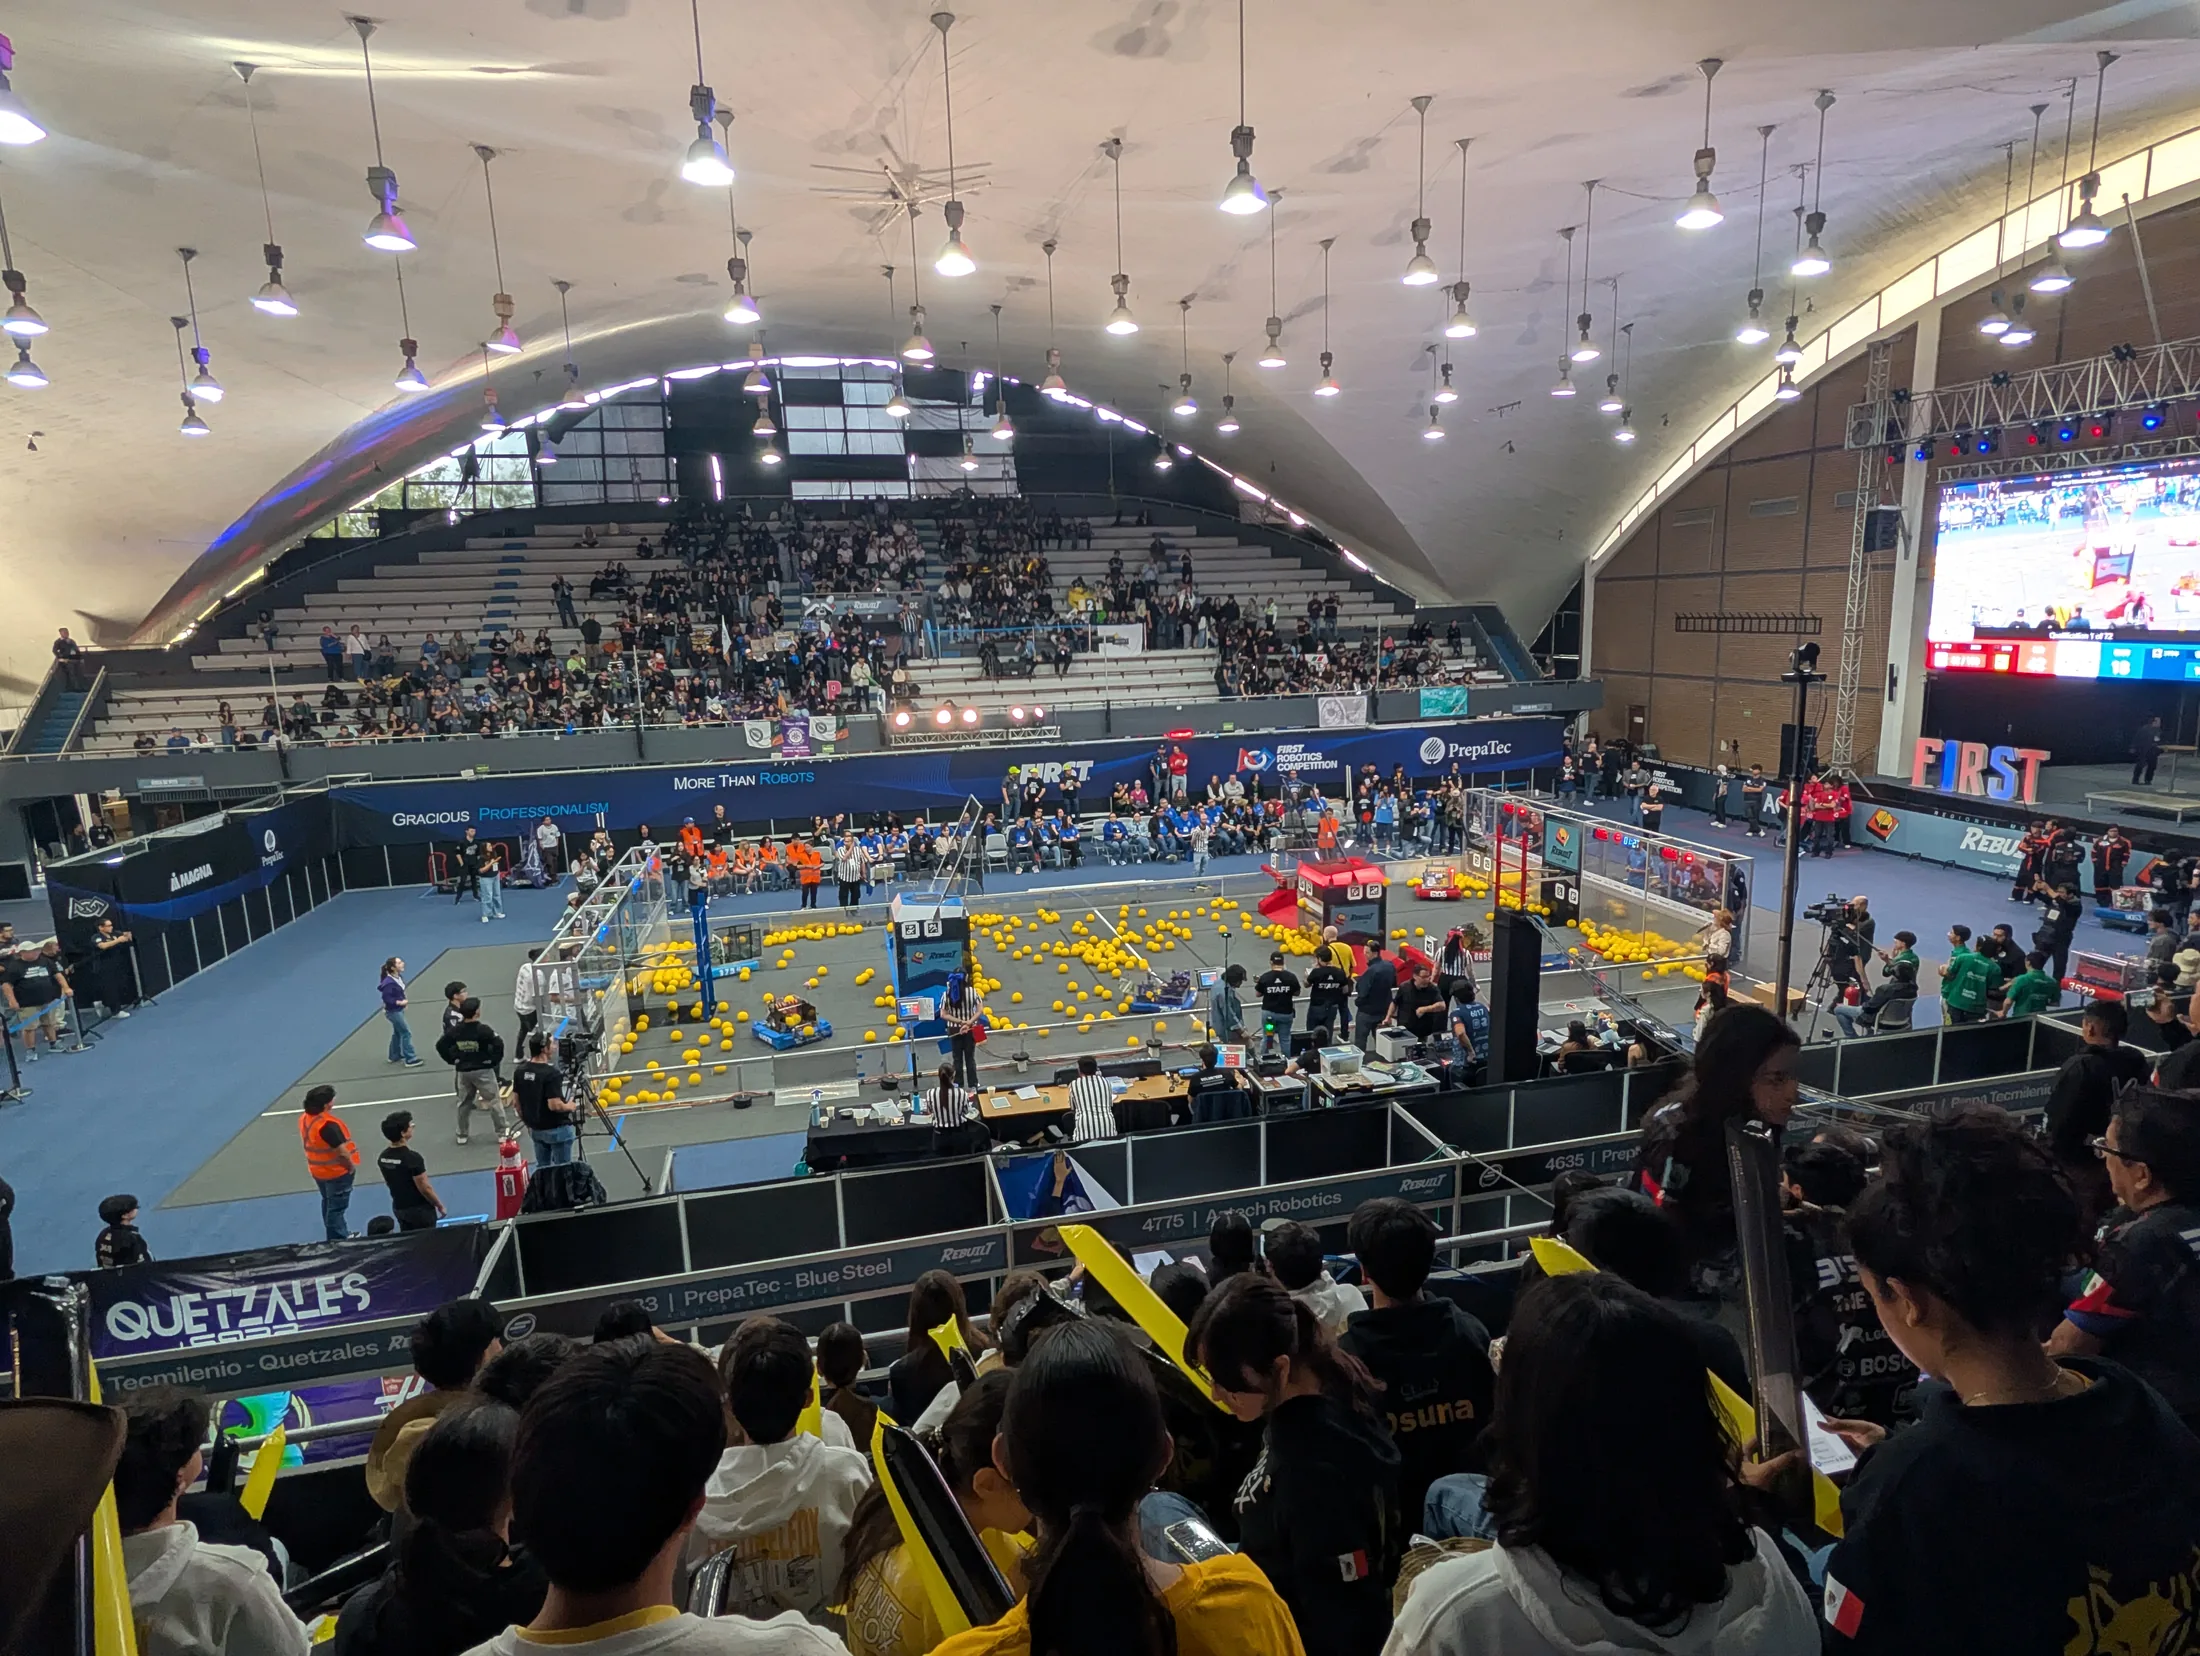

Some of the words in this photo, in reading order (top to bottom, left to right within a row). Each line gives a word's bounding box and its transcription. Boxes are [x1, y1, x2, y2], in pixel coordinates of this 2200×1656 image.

[1276, 743, 1305, 754] FIRST
[1276, 751, 1322, 763] ROBOTICS
[1448, 740, 1511, 760] PrepaTec
[1277, 759, 1338, 772] COMPETITION
[1911, 737, 2051, 805] FIRST
[674, 775, 715, 791] MORE
[719, 773, 756, 789] THAN
[759, 770, 815, 786] ROBOTS
[392, 809, 470, 827] GRACIOUS
[478, 801, 610, 821] PROFESSIONALISM
[1933, 810, 1997, 827] REGIONAL
[1959, 826, 2026, 859] REBU
[180, 862, 214, 888] MAGNA
[928, 950, 958, 961] REBUILT
[1266, 986, 1290, 994] STAFF
[2067, 982, 2096, 996] 3522
[1545, 1153, 1585, 1171] 4635
[1398, 1173, 1447, 1194] REBUILT
[1141, 1213, 1185, 1233] 4775
[1269, 1192, 1342, 1214] Robotics
[939, 1241, 996, 1263] REBUILT
[684, 1280, 781, 1307] PrepaTec
[795, 1269, 841, 1289] Blue
[842, 1257, 893, 1281] Steel
[105, 1272, 371, 1342] QUETZALES
[106, 1361, 242, 1392] Tecmilenio
[258, 1341, 380, 1371] Quetzales
[1860, 1354, 1914, 1377] BOSC
